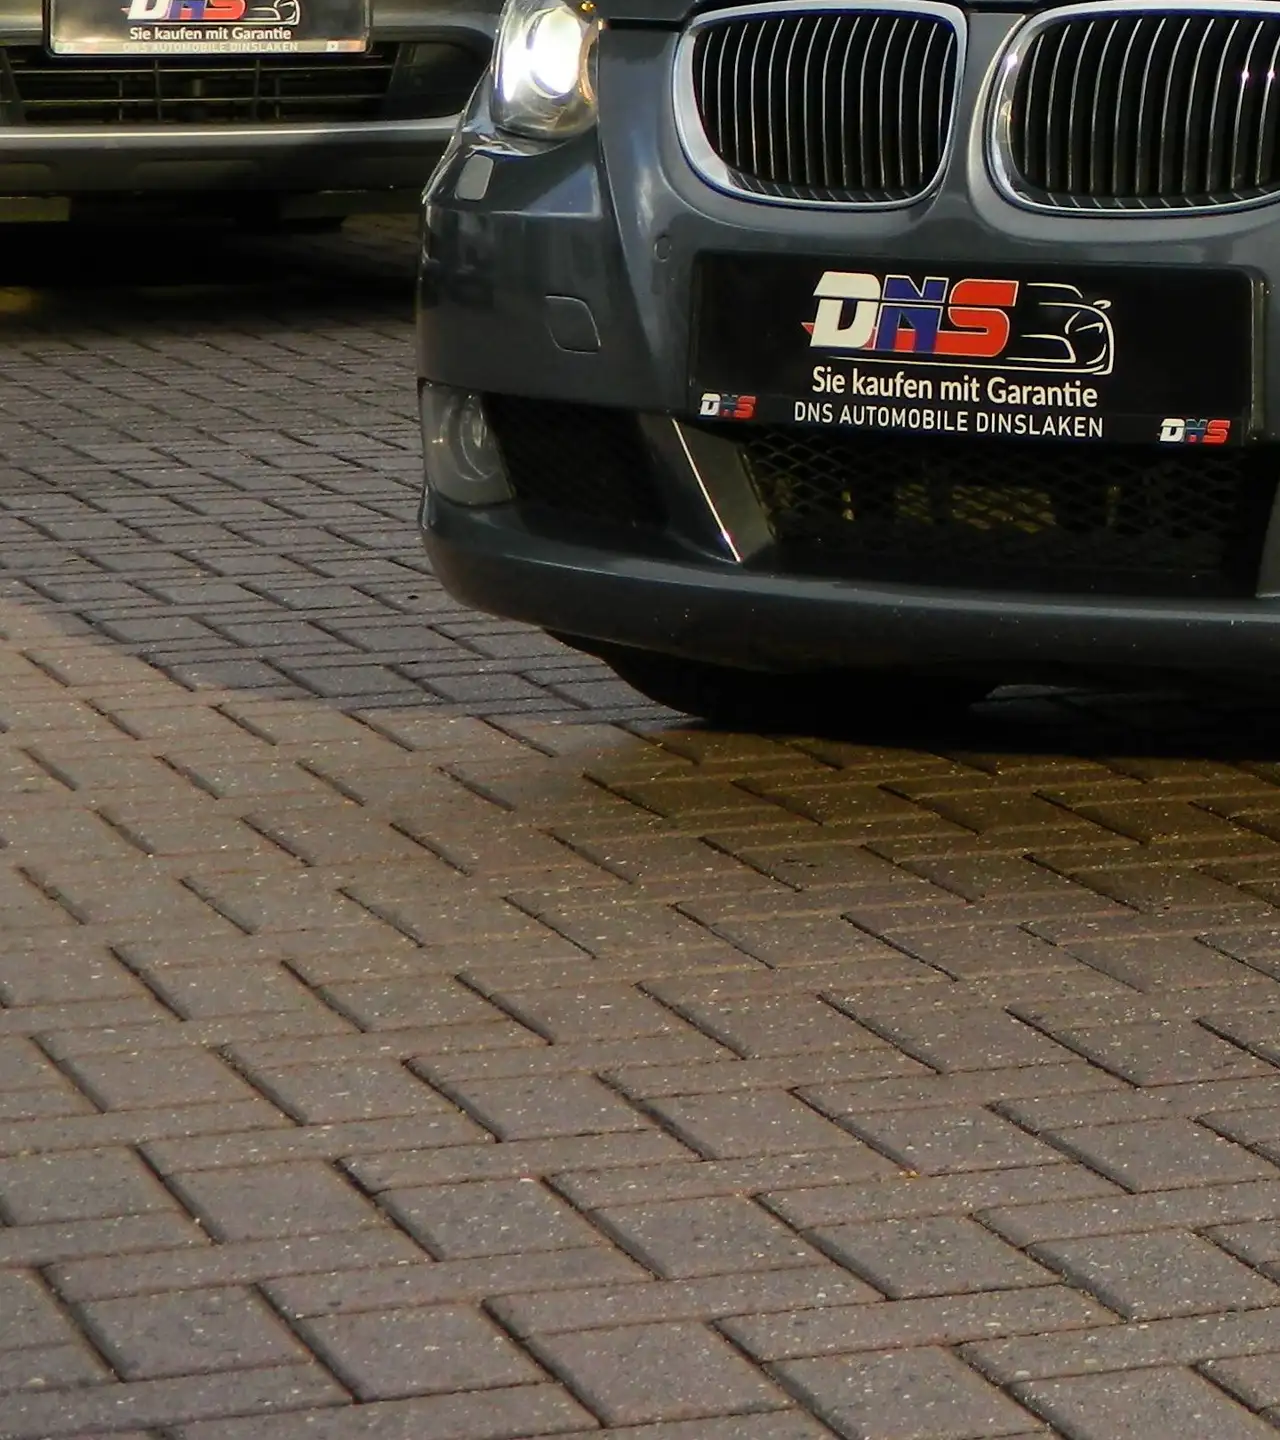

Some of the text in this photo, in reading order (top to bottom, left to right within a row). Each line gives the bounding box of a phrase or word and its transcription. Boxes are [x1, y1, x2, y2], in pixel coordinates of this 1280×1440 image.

[130, 26, 292, 41] Sie kaufen mit Garantie
[230, 41, 299, 53] DINSLAKEN
[809, 270, 1019, 358] DNS
[811, 365, 1098, 408] Sie kaufen mit Garantie
[700, 393, 756, 418] DNS
[794, 401, 1104, 439] DNS AUTOMOBILE DINSLAKEN
[1160, 418, 1231, 444] DNS
